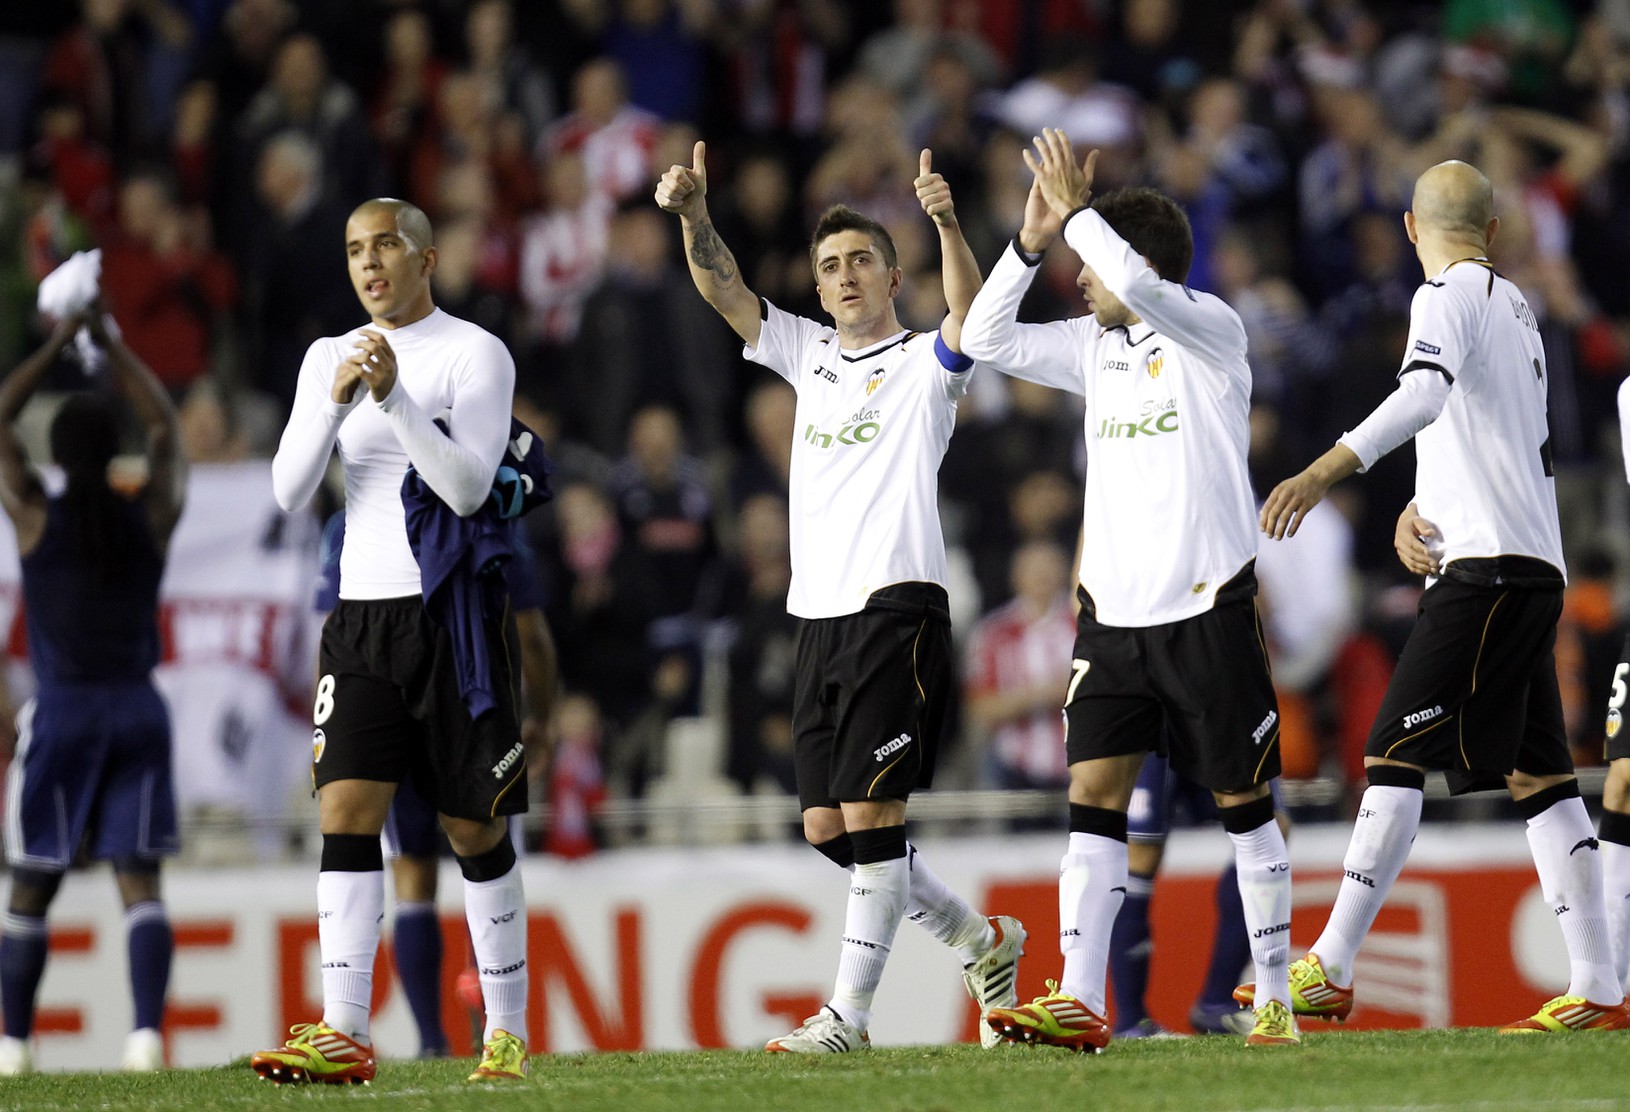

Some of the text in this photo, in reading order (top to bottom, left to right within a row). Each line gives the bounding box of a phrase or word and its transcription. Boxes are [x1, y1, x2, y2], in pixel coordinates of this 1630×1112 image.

[1140, 397, 1177, 417] Sola
[313, 674, 336, 726] 8
[1608, 662, 1629, 709] 5
[1402, 705, 1444, 729] Joma
[491, 741, 524, 779] Joma
[873, 733, 912, 762] Joma
[1253, 922, 1292, 939] Jom
